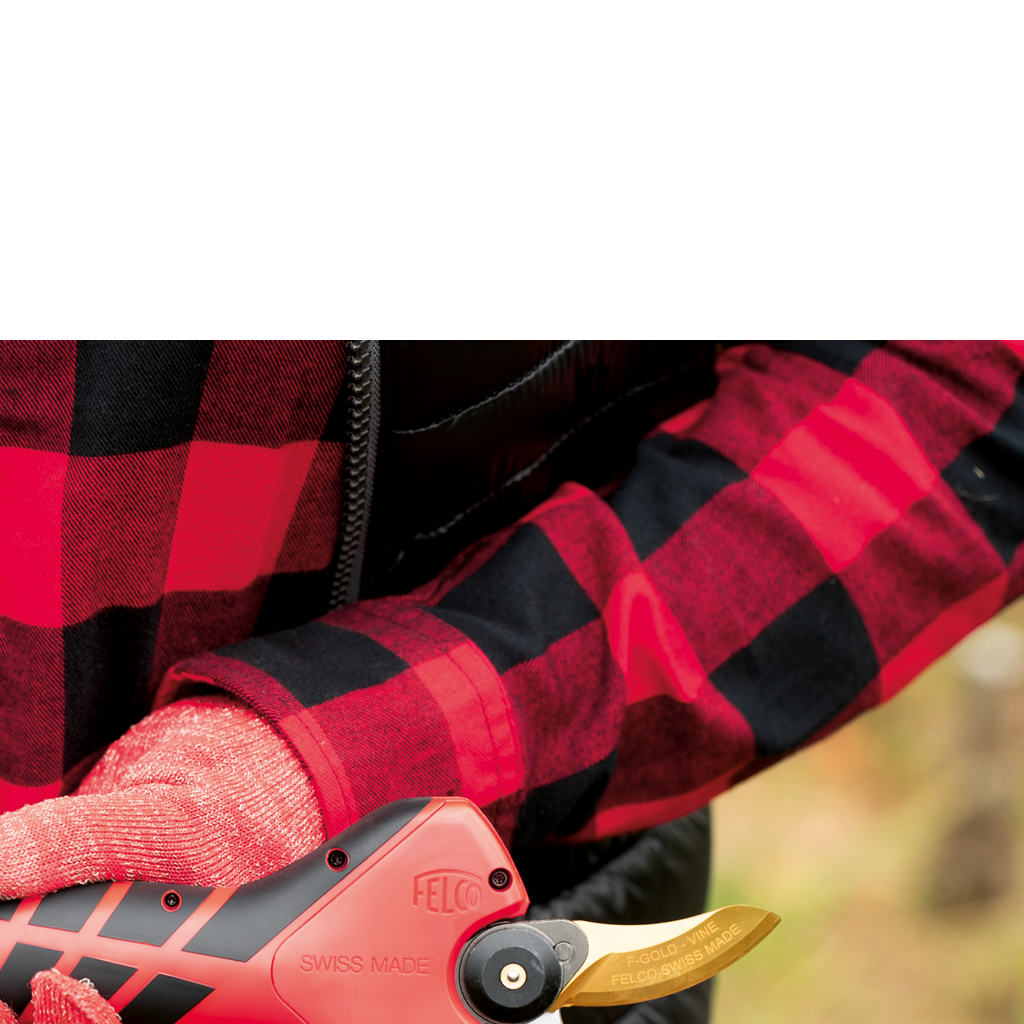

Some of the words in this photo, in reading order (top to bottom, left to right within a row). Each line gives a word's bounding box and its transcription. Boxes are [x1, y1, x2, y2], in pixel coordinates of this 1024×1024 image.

[413, 869, 482, 914] FELCO
[300, 954, 364, 974] SWISS
[371, 956, 430, 976] MADE
[611, 968, 658, 985] FELCO
[660, 949, 704, 975] SWISS
[704, 923, 741, 955] MADE
[627, 944, 678, 967] F-GOLD
[686, 920, 719, 945] VINE
